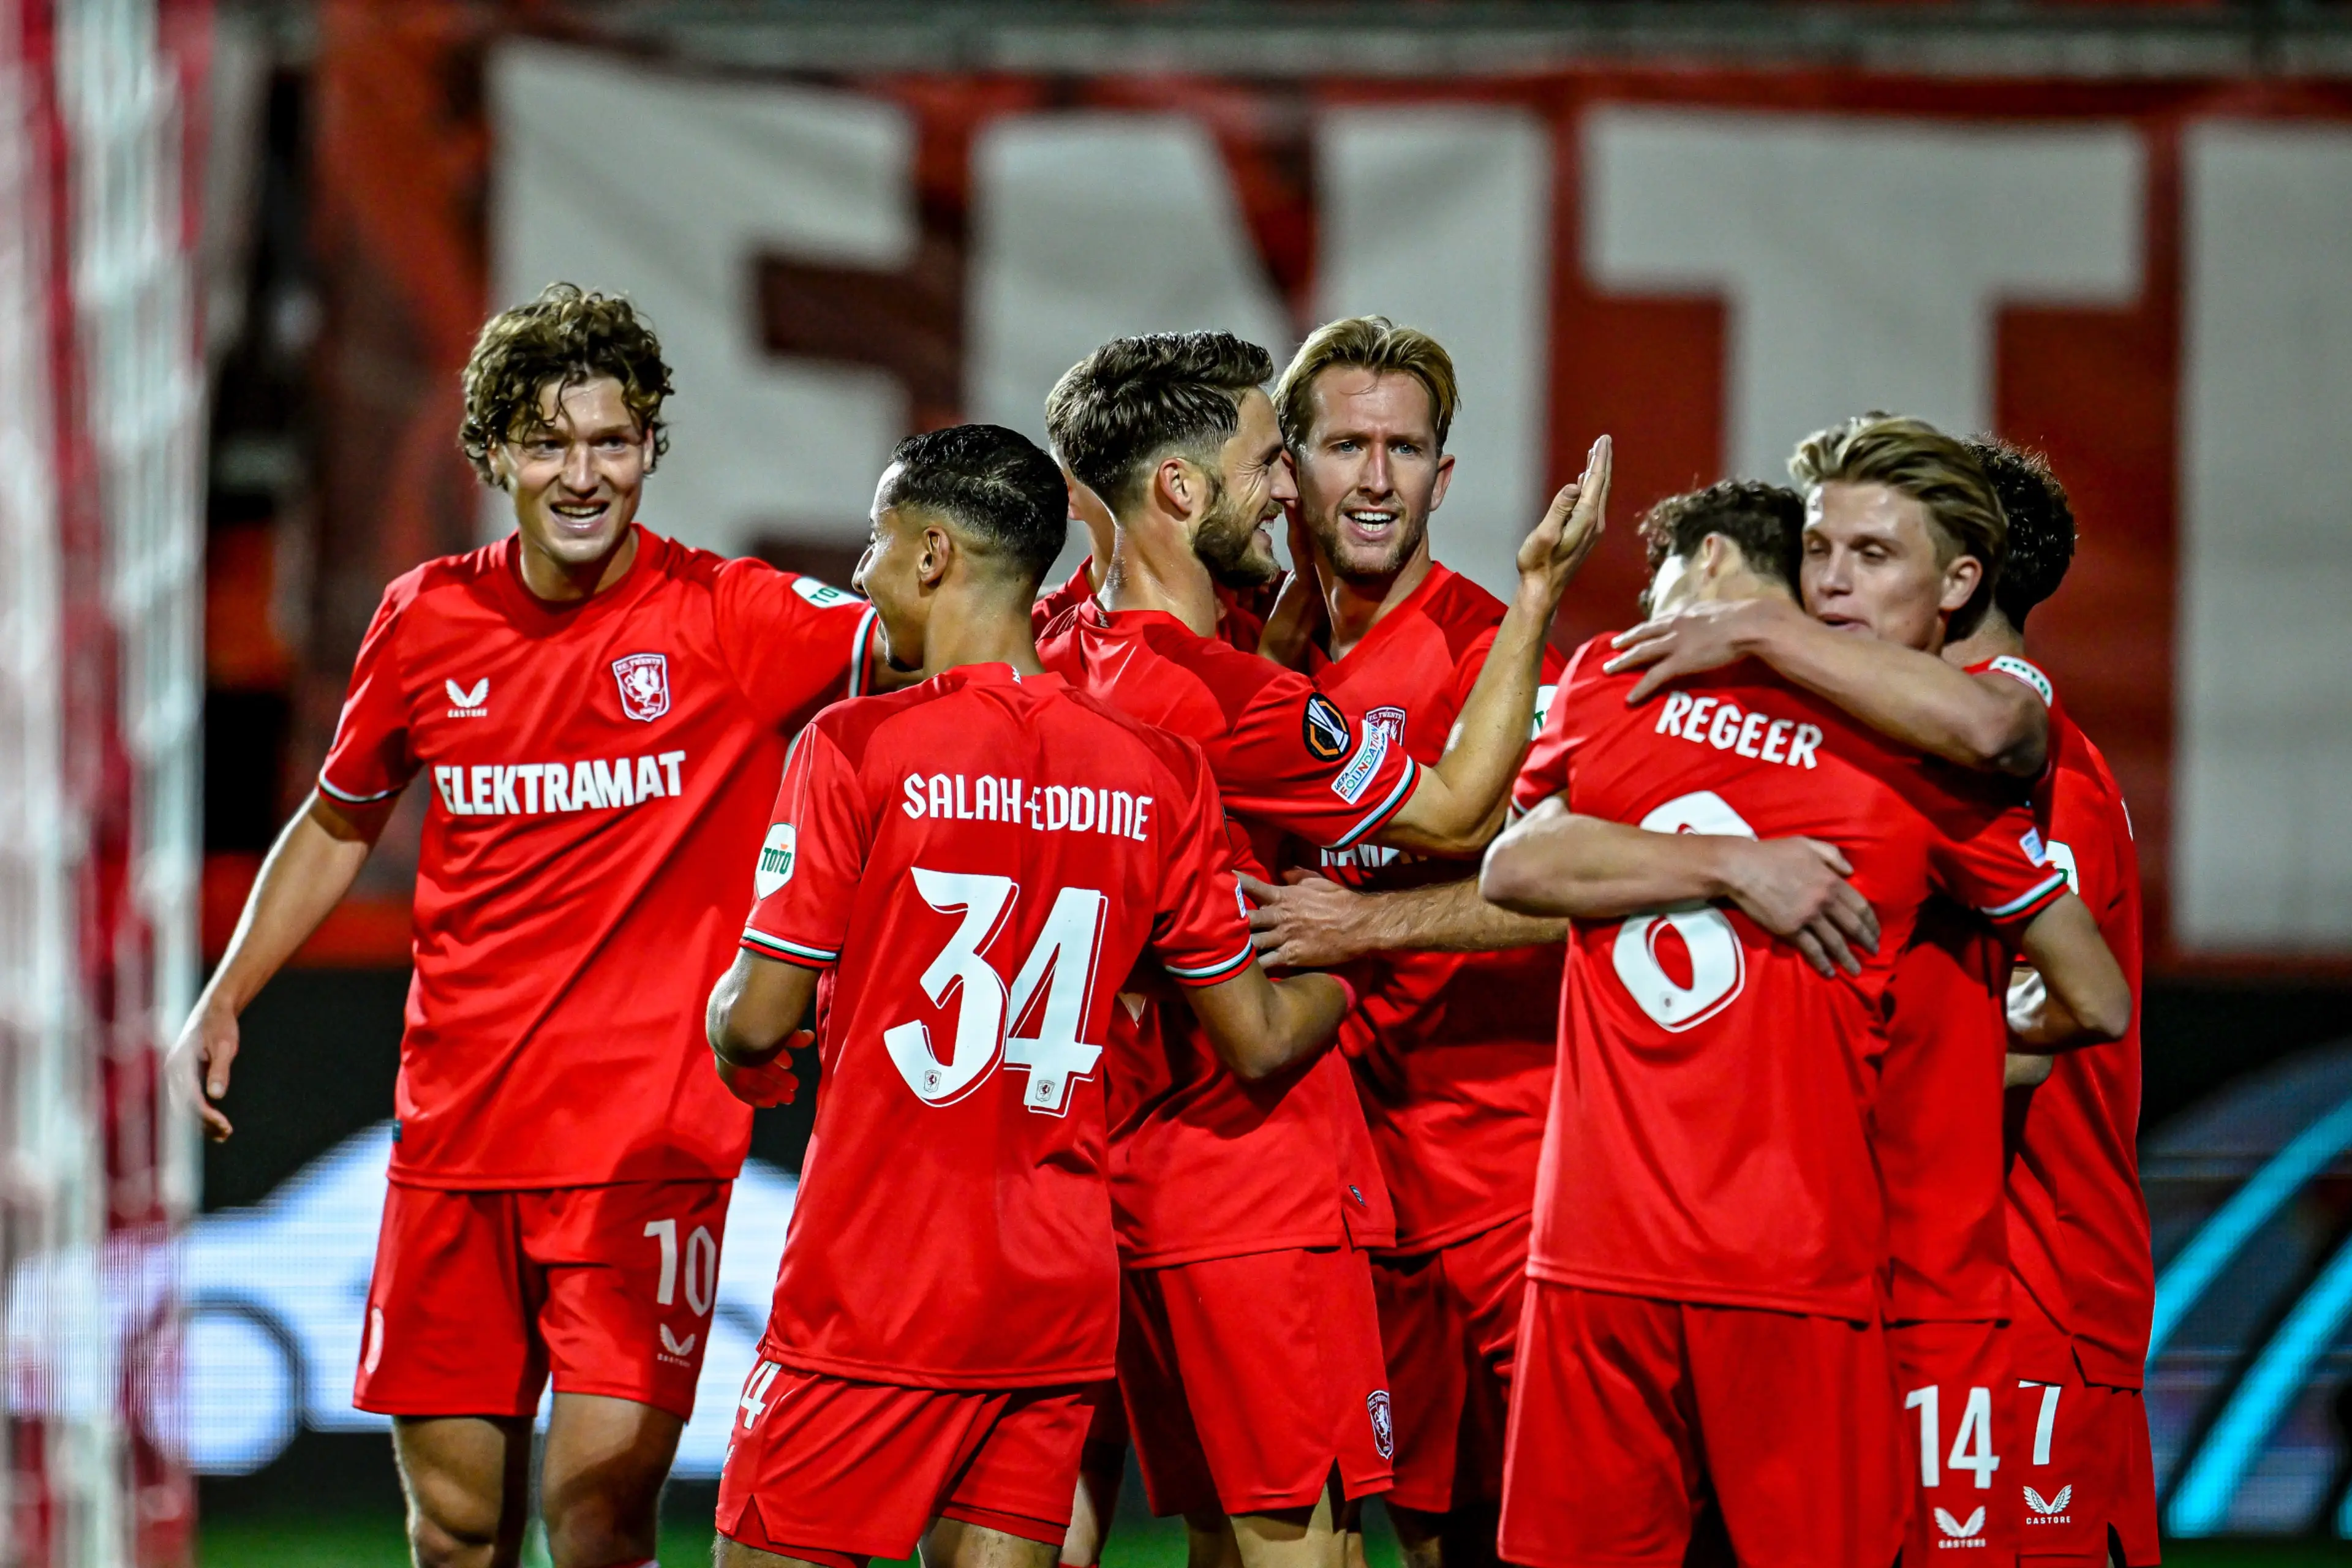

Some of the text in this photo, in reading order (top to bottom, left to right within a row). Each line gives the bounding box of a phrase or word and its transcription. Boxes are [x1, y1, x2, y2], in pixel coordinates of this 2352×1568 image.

[1339, 725, 1381, 797] FOUNDATION
[1655, 690, 1823, 770] REGEER
[434, 750, 687, 815] ELEKTRAMAT
[902, 772, 1153, 842] SALAH-EDDINE
[1334, 772, 1350, 791] UEFA
[761, 847, 792, 875] TOTO
[883, 866, 1109, 1118] 34
[643, 1218, 717, 1317] 10
[740, 1360, 782, 1430] 4
[2018, 1380, 2061, 1465] 7
[1904, 1385, 2000, 1489] 14
[2026, 1516, 2071, 1525] CASTORE
